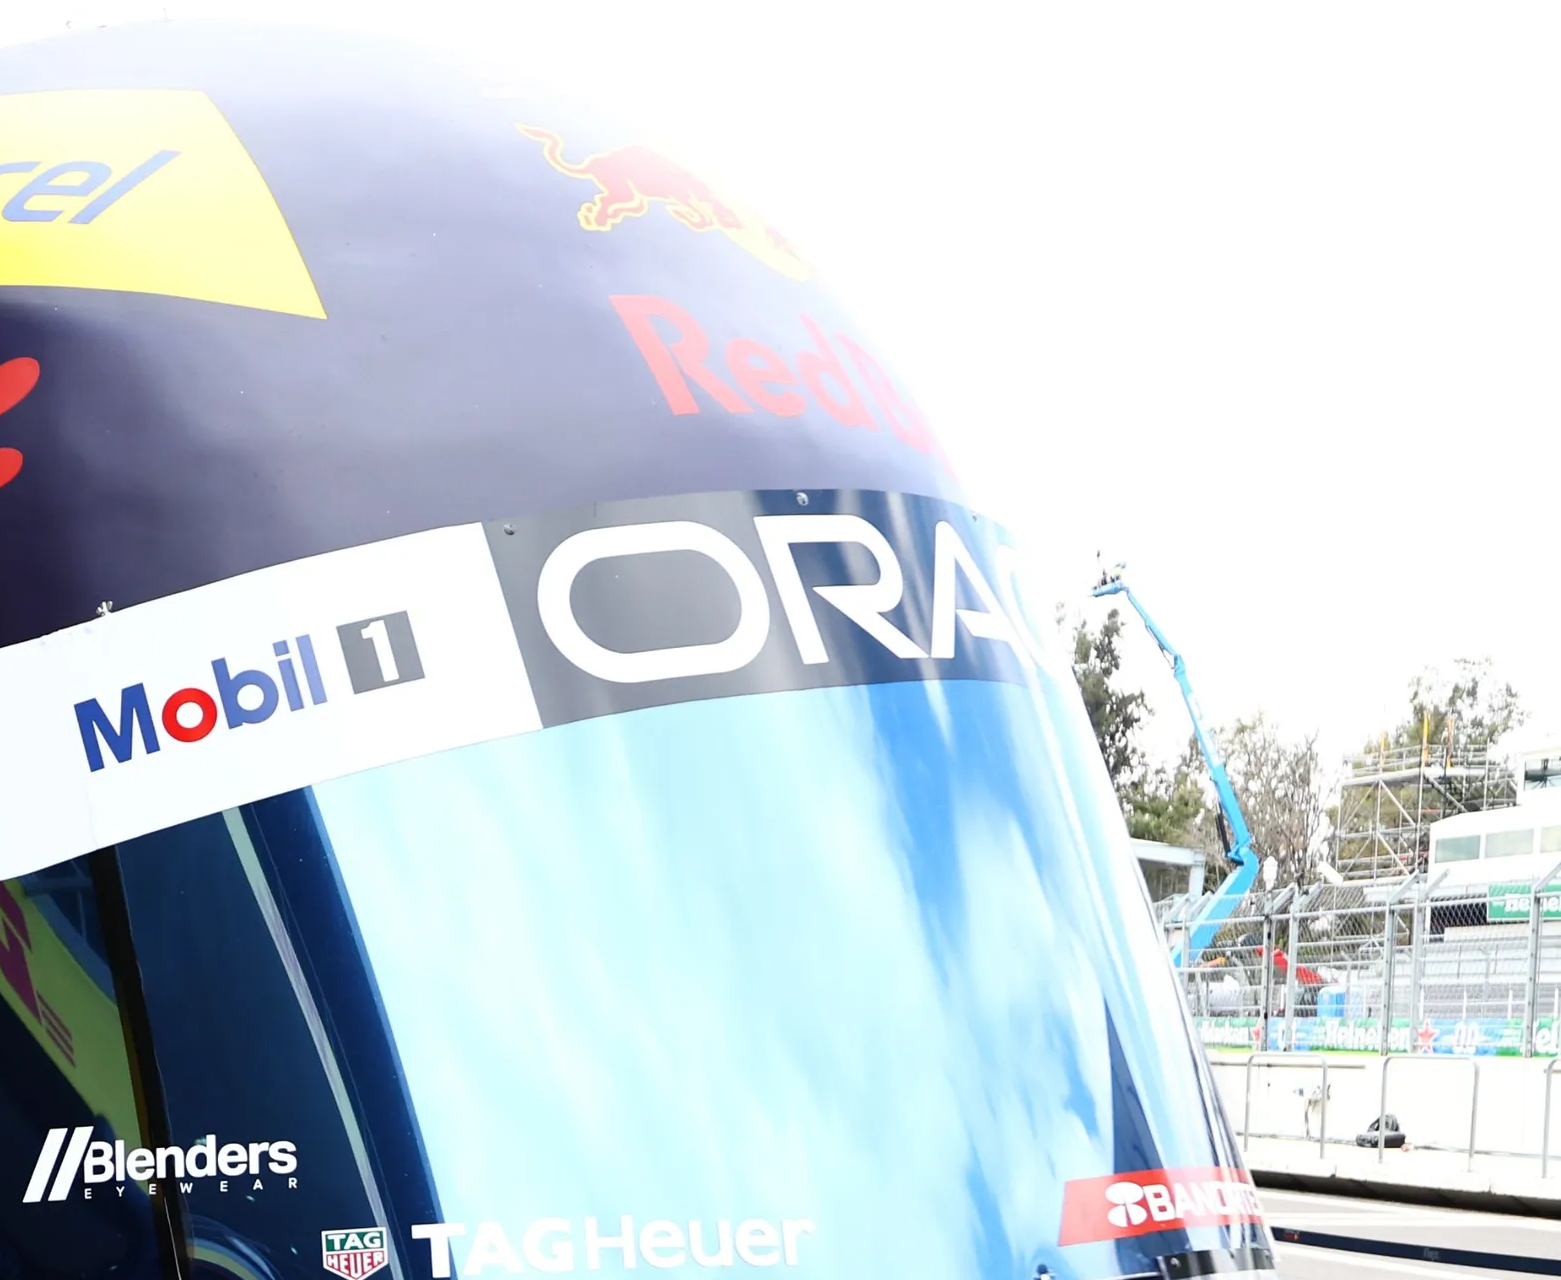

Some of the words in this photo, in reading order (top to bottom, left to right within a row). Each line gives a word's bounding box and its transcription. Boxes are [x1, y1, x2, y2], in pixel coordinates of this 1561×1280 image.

[74, 633, 328, 773] Mobil
[83, 1134, 298, 1184] Blenders
[84, 1177, 298, 1200] EYEWEAR
[326, 1230, 383, 1250] TAG
[326, 1252, 385, 1277] HEUER
